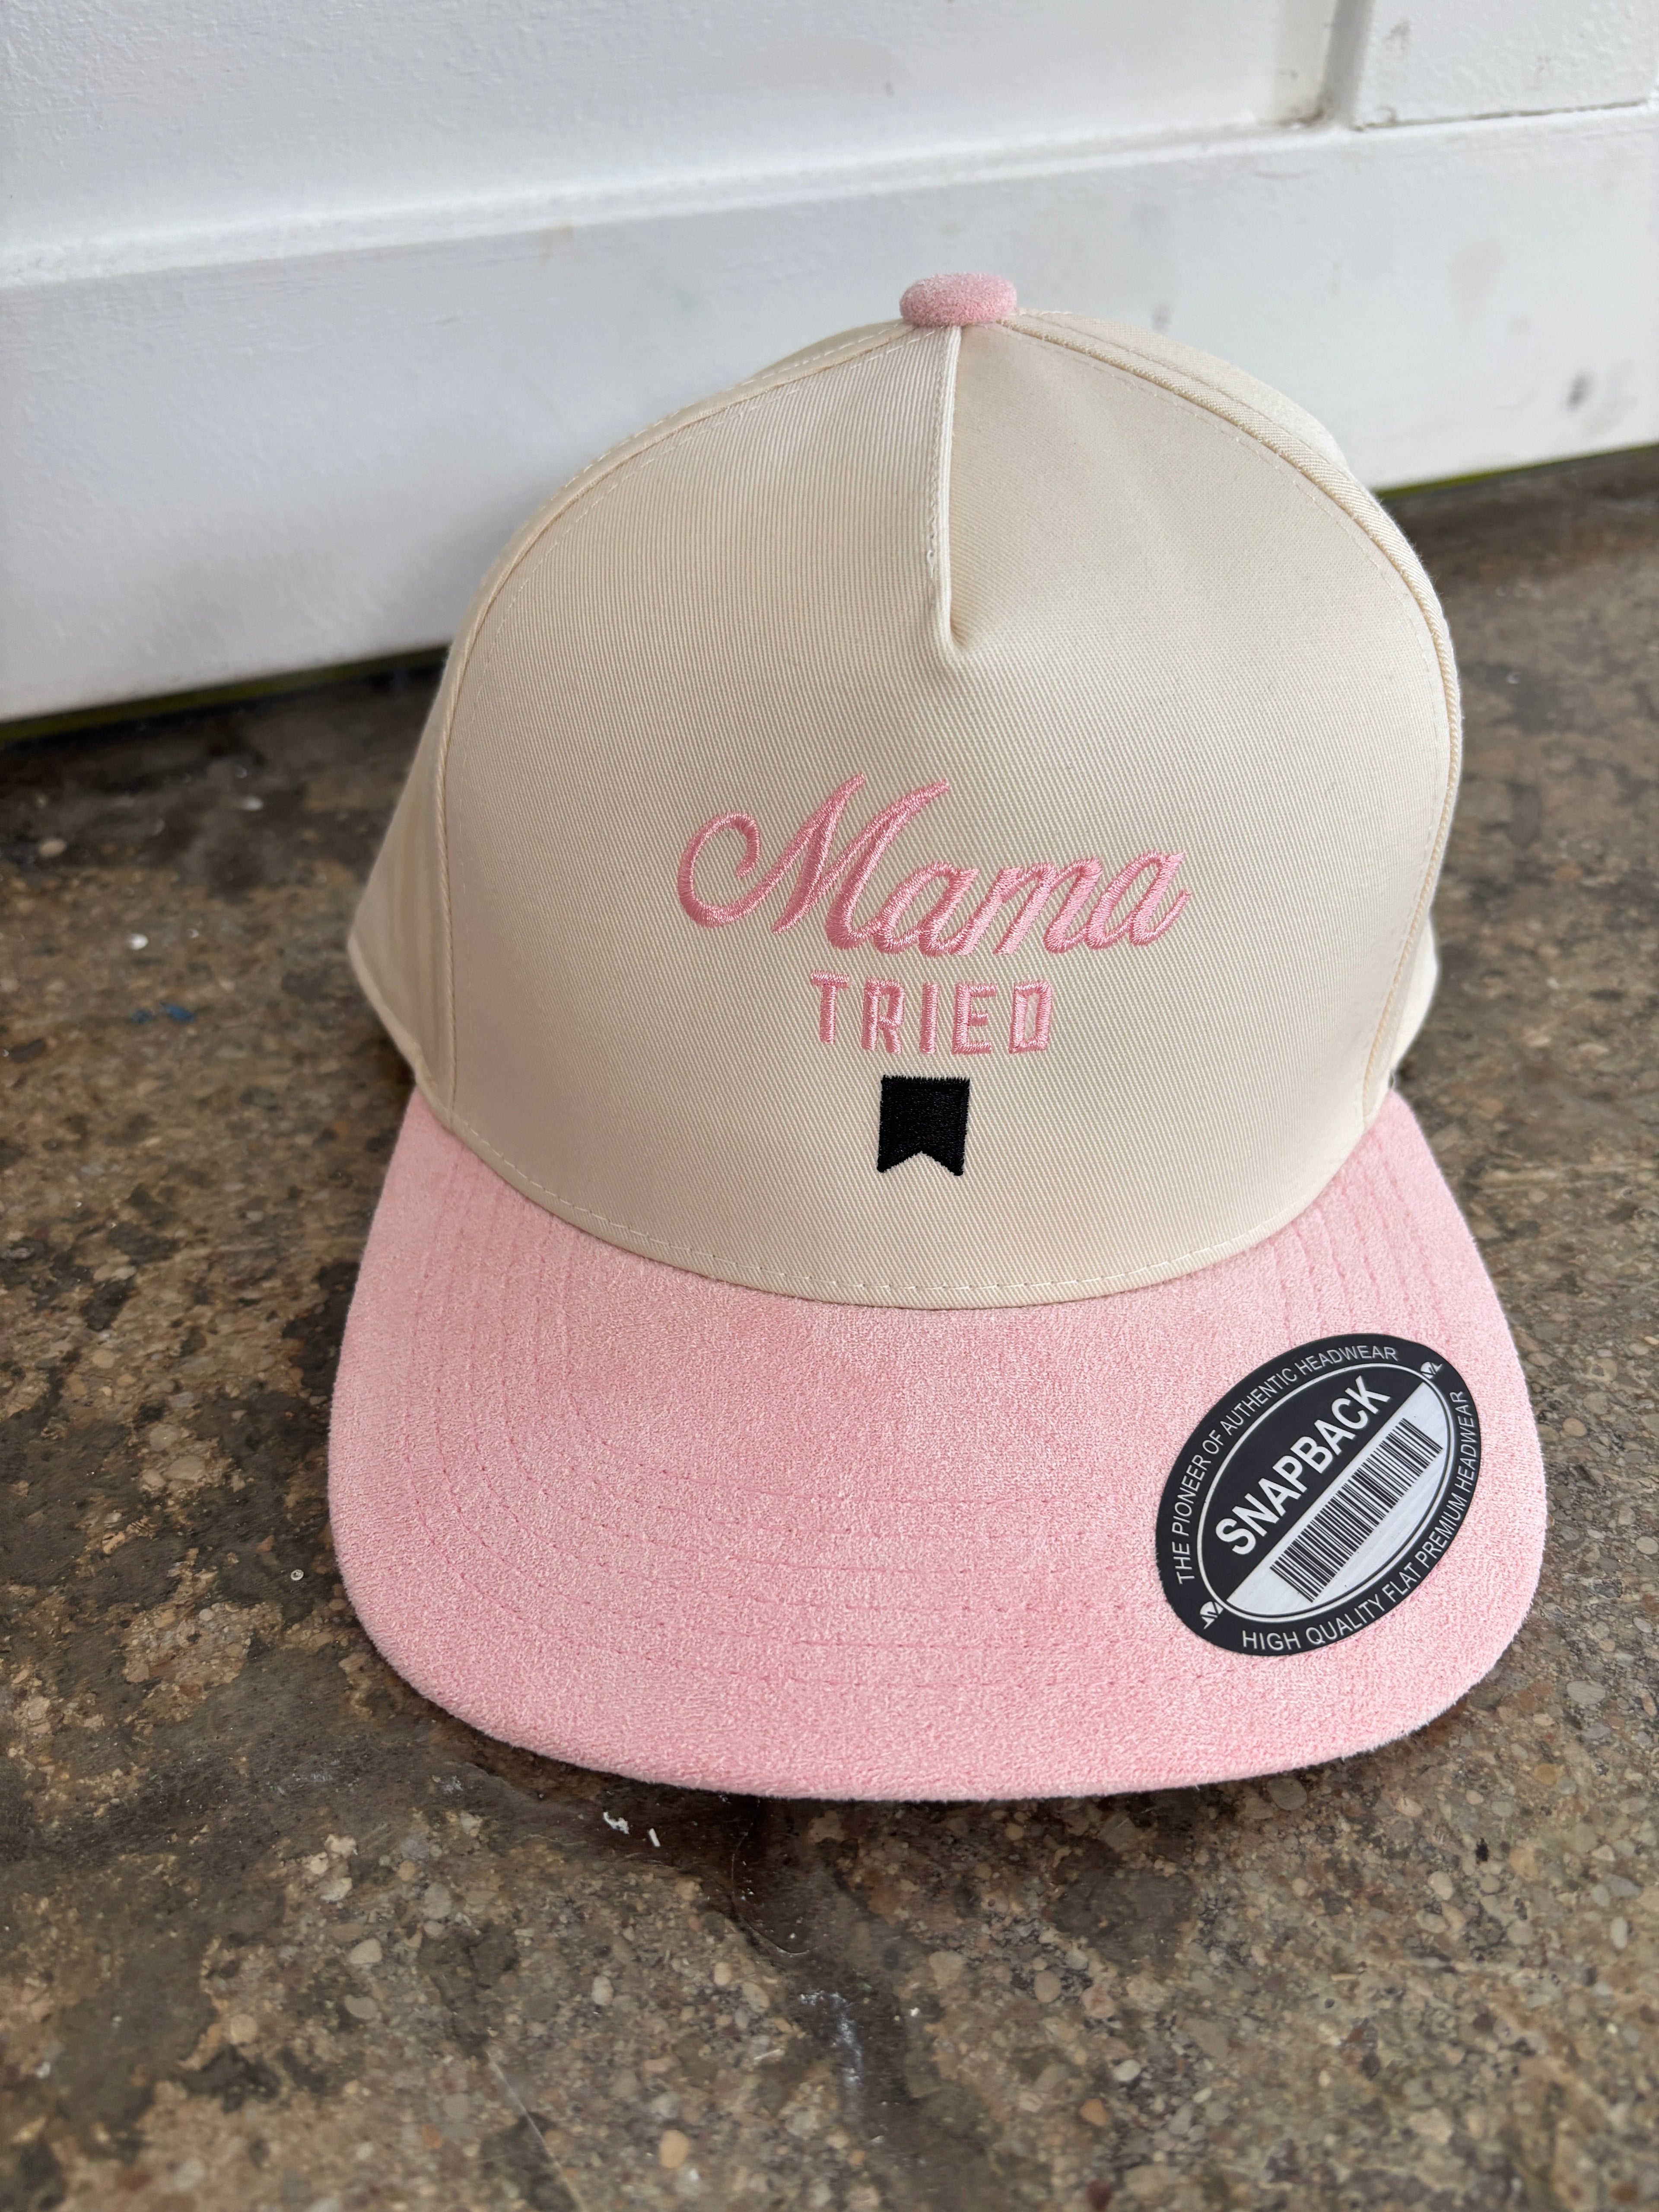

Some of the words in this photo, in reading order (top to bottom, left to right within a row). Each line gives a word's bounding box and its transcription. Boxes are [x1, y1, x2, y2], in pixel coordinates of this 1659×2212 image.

[677, 773, 1191, 957] Mama
[810, 970, 1052, 1055] TRIED
[1294, 1345, 1398, 1376] HEADWEAR
[1220, 1368, 1298, 1436] AUTHENTIC
[1202, 1429, 1224, 1455] OF
[1215, 1376, 1391, 1555] SNAPBACK
[1172, 1456, 1211, 1535] PIONEER
[1242, 1630, 1301, 1651] HIGH
[1306, 1595, 1386, 1646] QUALITY
[1382, 1563, 1422, 1602] FLAT
[1418, 1493, 1468, 1568] PREMIUM
[1449, 1391, 1477, 1493] HEADWEAR
[1173, 1541, 1195, 1584] THE
